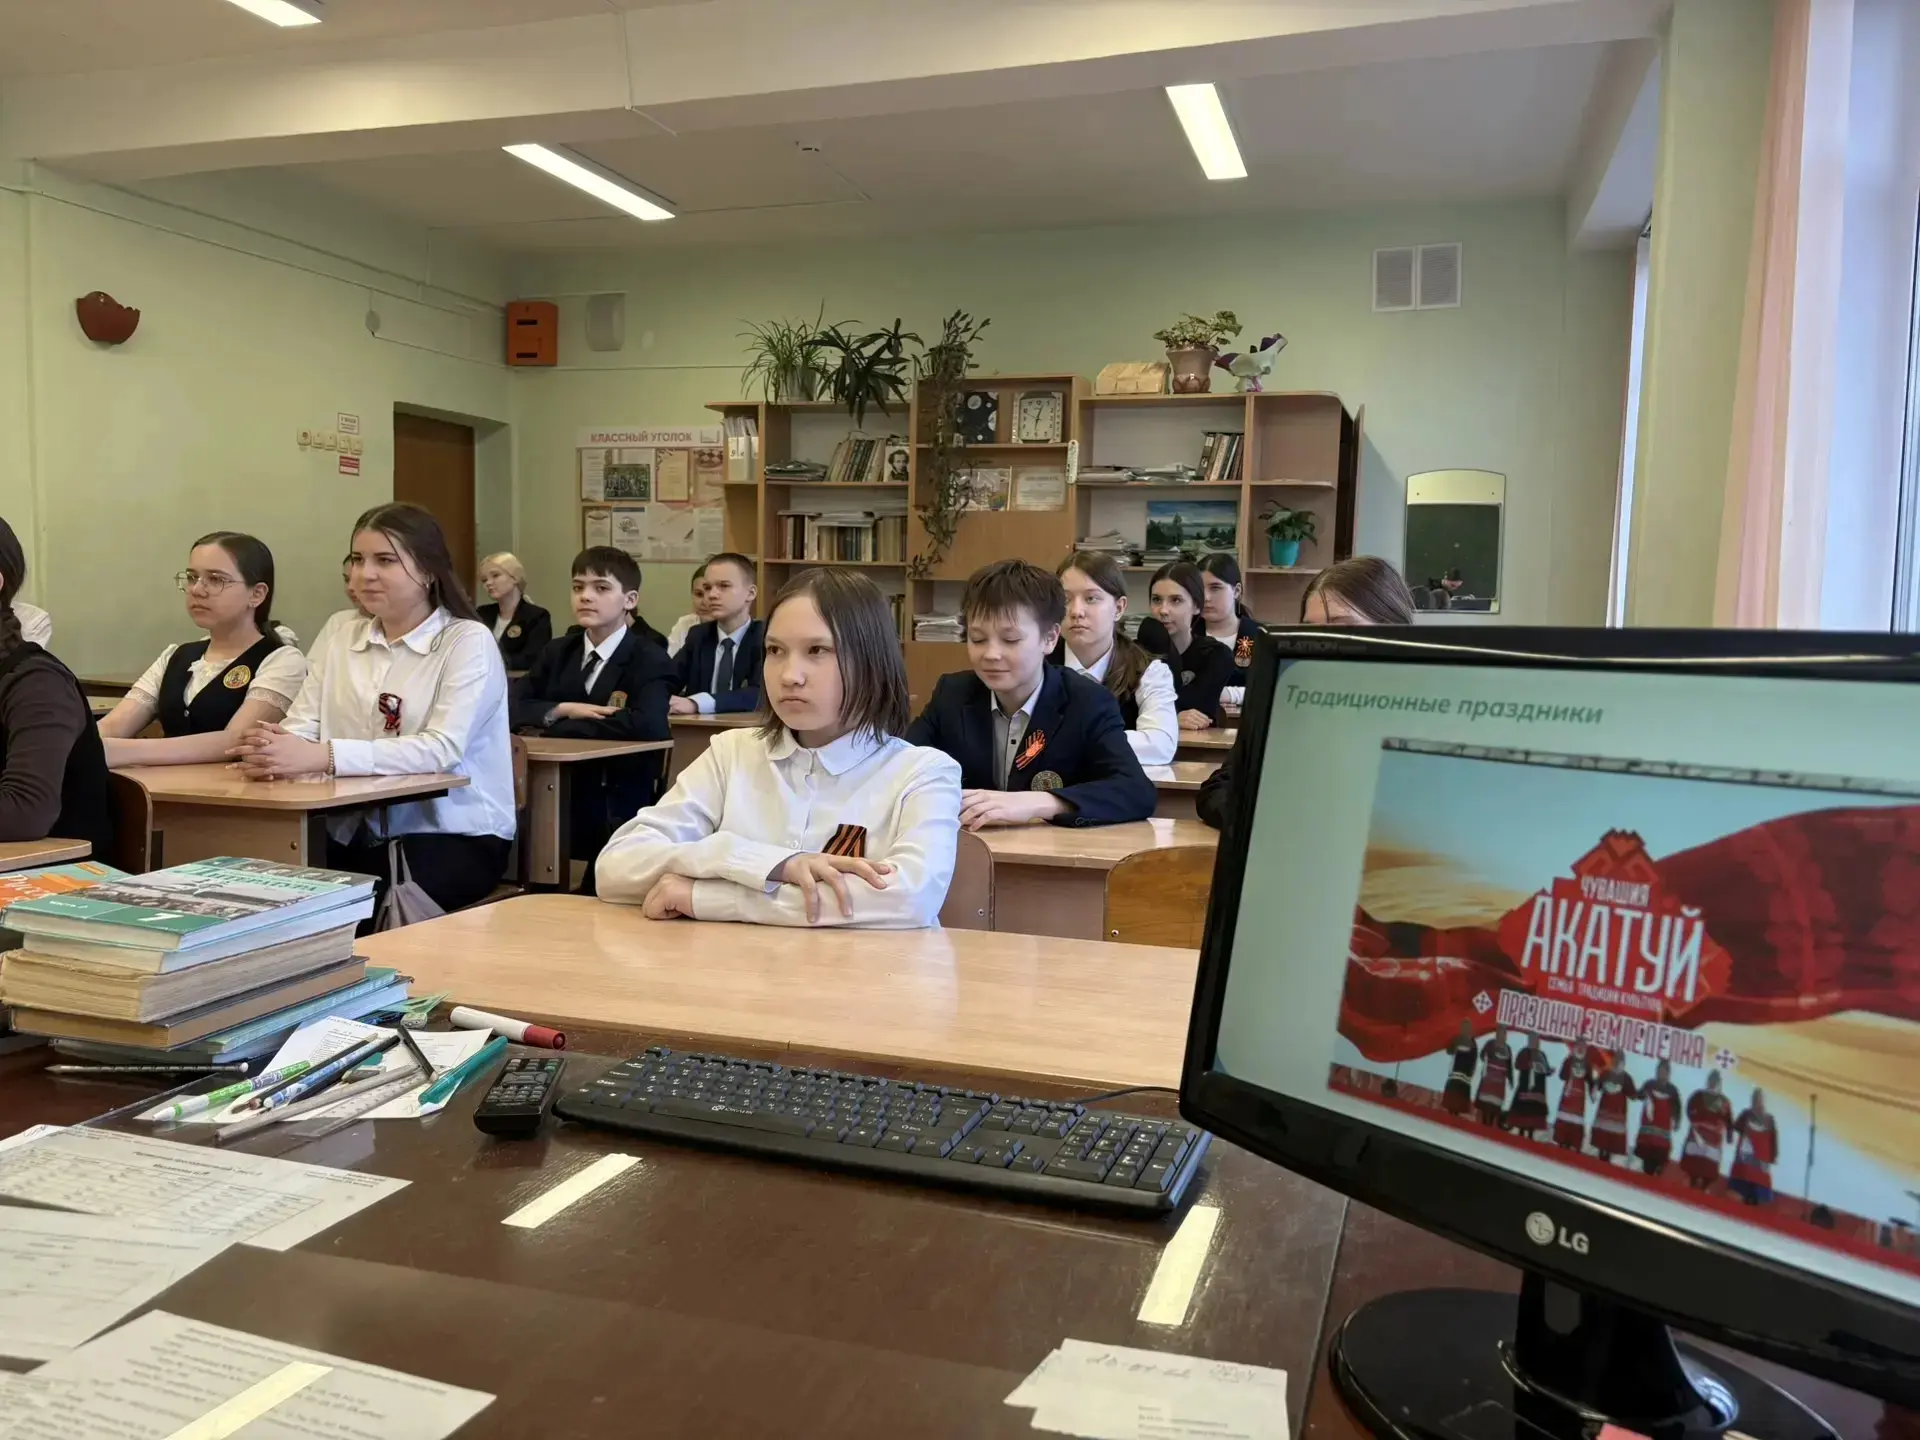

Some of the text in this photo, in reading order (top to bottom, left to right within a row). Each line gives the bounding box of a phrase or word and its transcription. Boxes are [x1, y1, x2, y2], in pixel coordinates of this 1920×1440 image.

[590, 431, 693, 443] КЛАССНЫЙ УГОЛОК
[1286, 684, 1604, 724] Традиционные праздники
[1581, 875, 1650, 907] ЧУВАШИЯ
[1520, 895, 1705, 1003] АКАТУЙ
[1498, 989, 1705, 1069] ПРАЗДНИК ЗЕМЛЕДЕЛИЯ
[1558, 1226, 1590, 1256] LG
